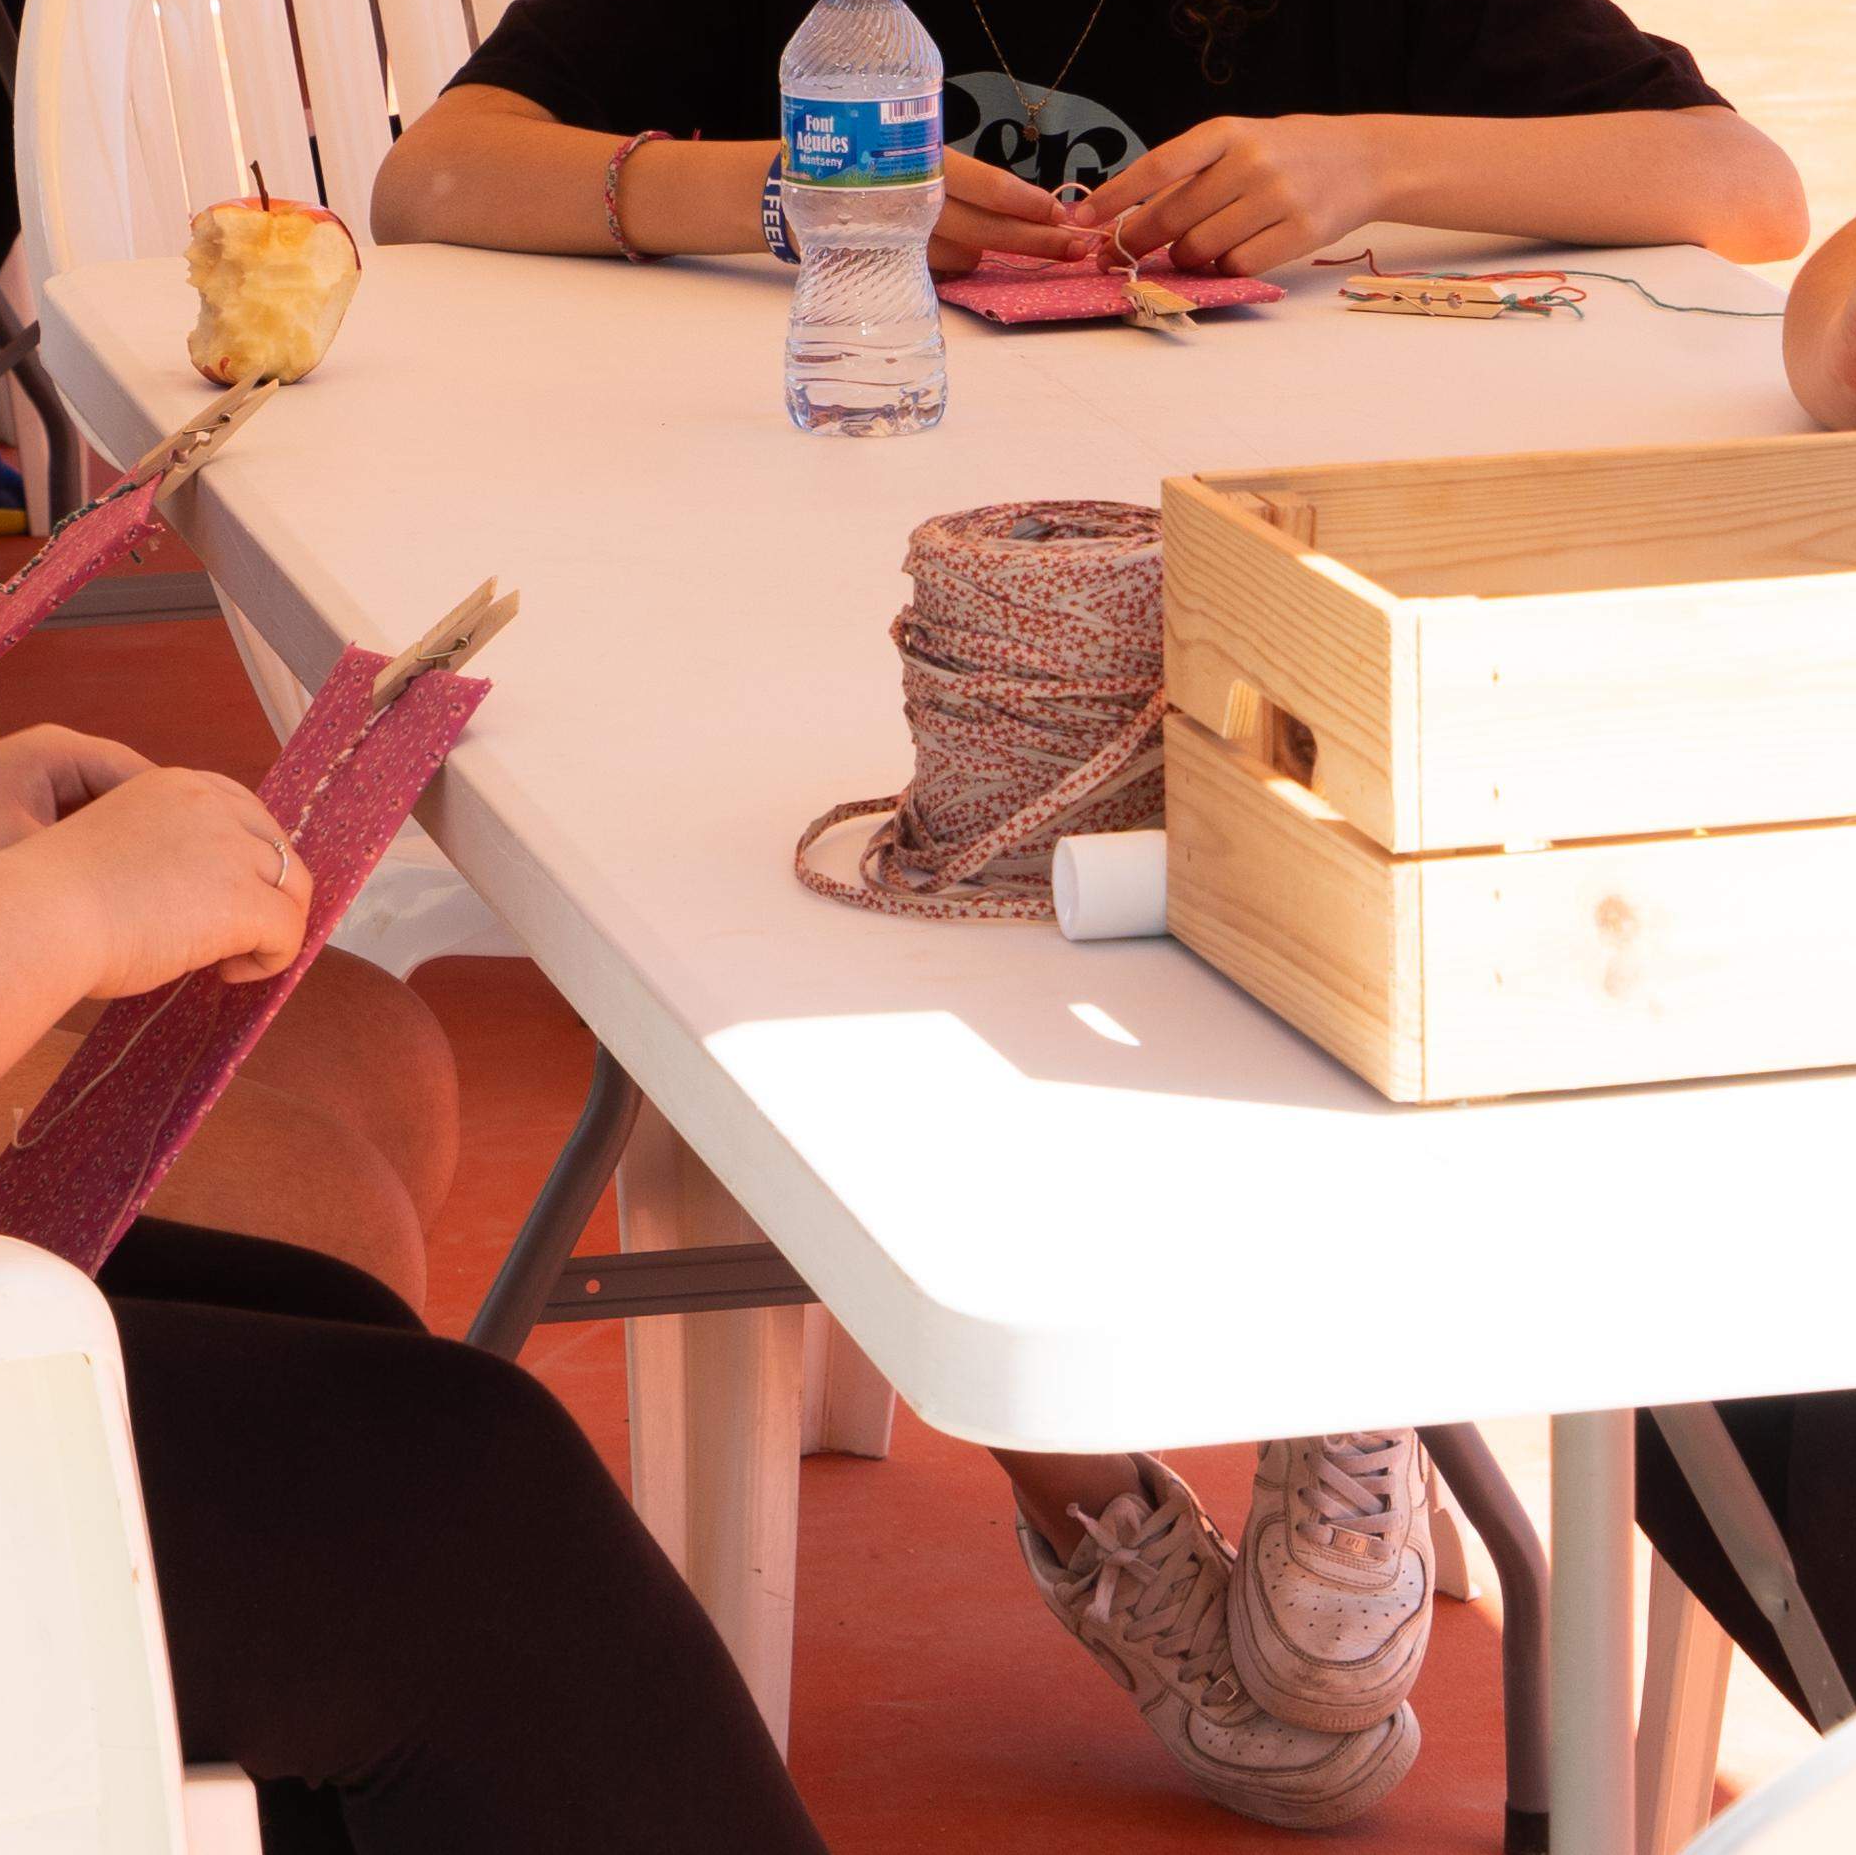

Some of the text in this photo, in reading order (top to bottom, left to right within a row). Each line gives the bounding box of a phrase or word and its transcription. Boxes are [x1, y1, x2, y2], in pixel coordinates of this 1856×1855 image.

[805, 114, 834, 133] Font
[796, 131, 849, 154] Agudes
[798, 154, 844, 169] Montseny
[763, 194, 785, 253] FEEL
